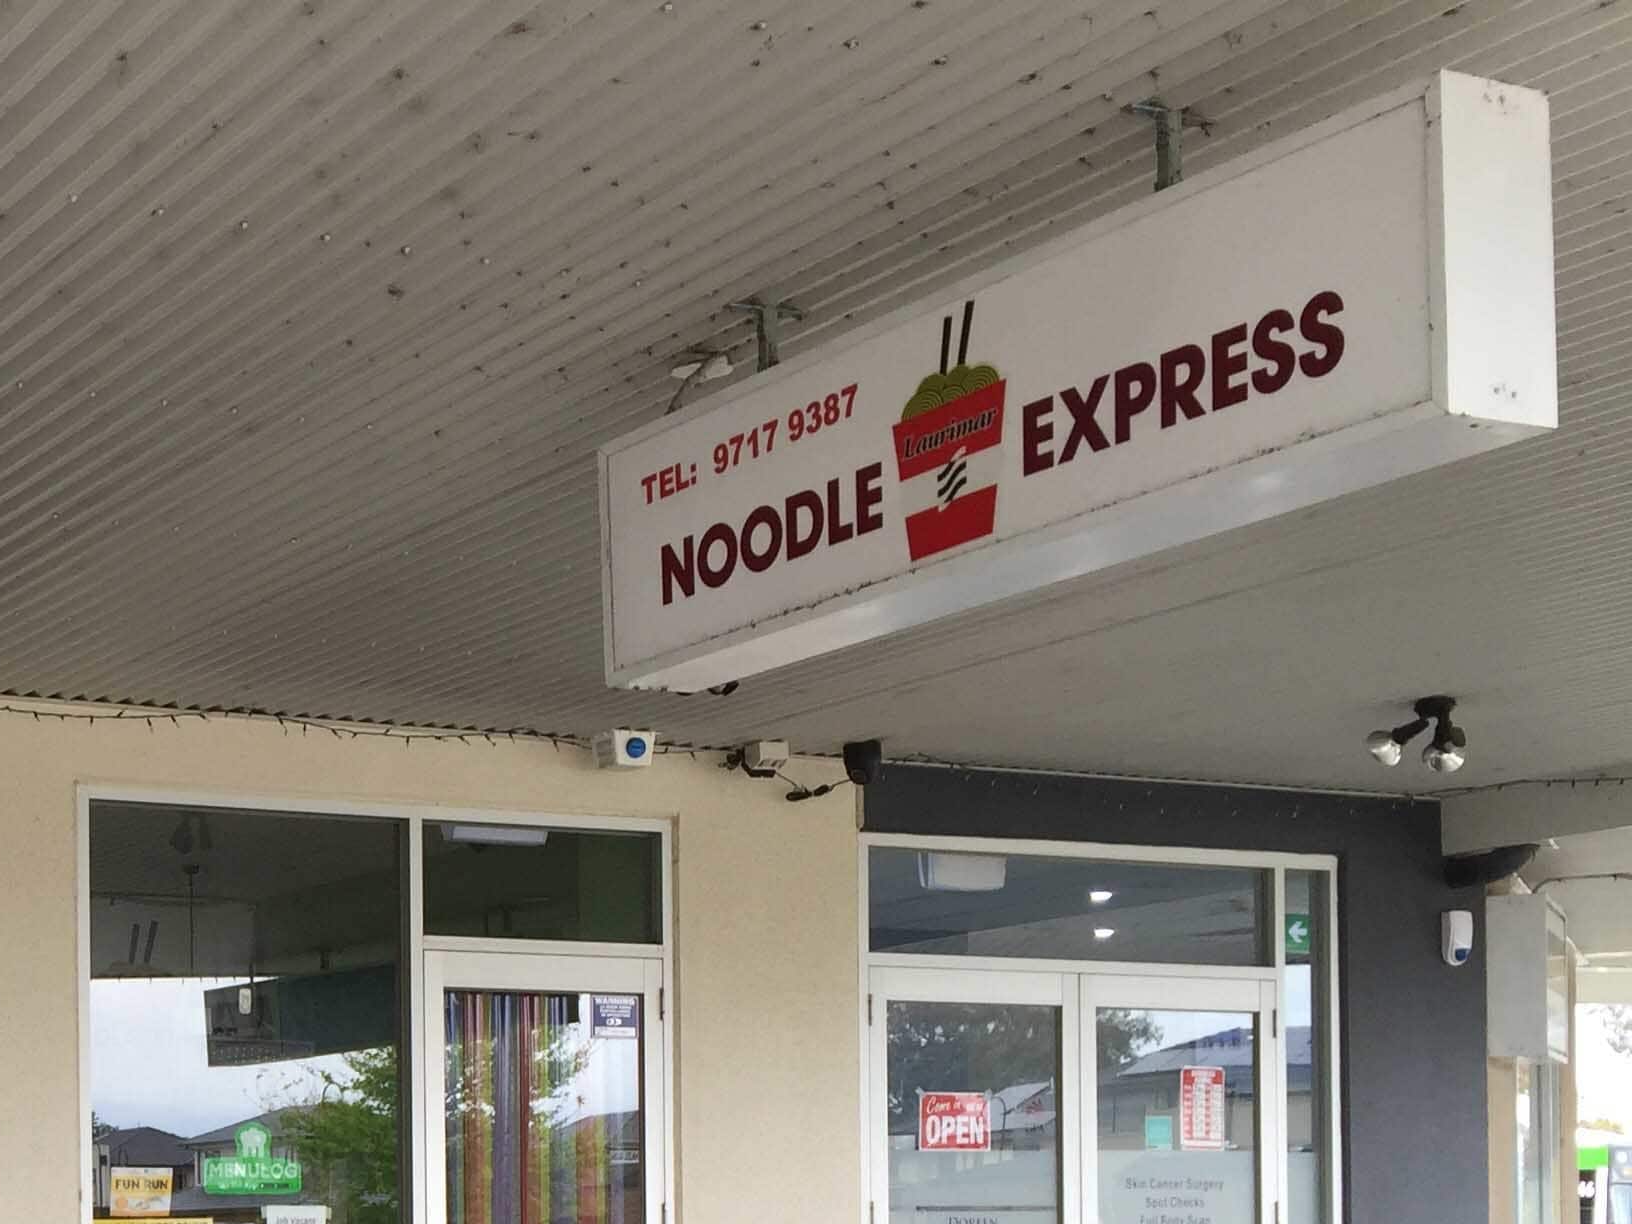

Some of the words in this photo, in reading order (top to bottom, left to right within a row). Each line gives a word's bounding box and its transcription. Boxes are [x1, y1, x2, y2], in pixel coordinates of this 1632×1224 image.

[1023, 290, 1345, 477] EXPRESS
[641, 462, 697, 505] TEL:
[713, 419, 779, 474] 9717
[788, 384, 858, 442] 9387
[904, 406, 997, 460] Laurimar
[661, 461, 883, 606] NOODLE
[926, 1115, 984, 1145] OPEN
[115, 1179, 140, 1190] FUN
[144, 1179, 168, 1190] RUN
[209, 1162, 298, 1179] MENULOG
[1125, 1178, 1147, 1190] Skin
[1149, 1178, 1183, 1190] Cancer
[1186, 1178, 1224, 1192] Surgery
[1170, 1197, 1205, 1208] Checks
